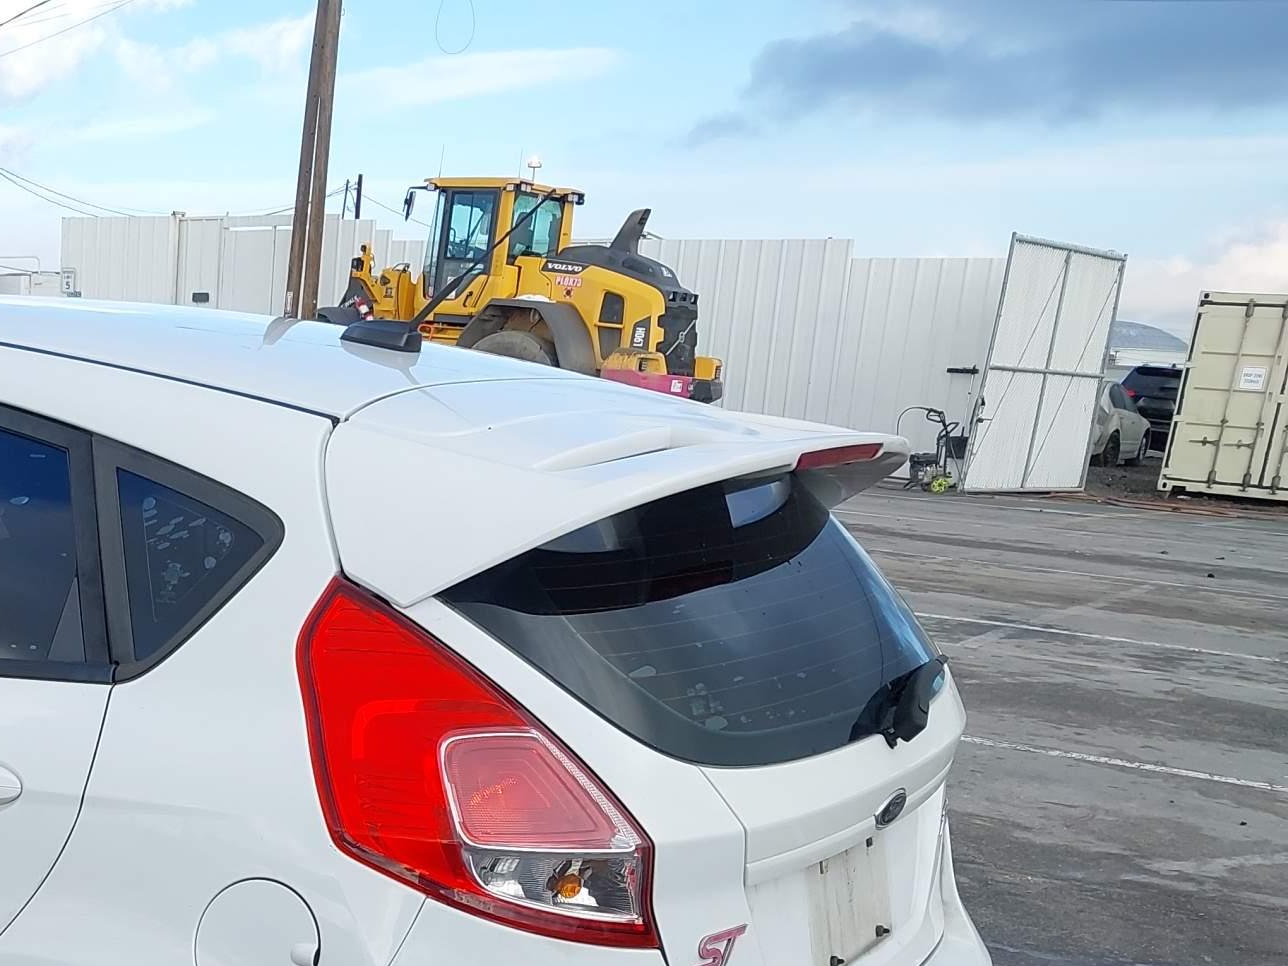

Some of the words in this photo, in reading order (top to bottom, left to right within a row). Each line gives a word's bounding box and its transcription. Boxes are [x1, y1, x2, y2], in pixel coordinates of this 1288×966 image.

[547, 262, 583, 273] VOLVO
[65, 281, 71, 290] 5
[632, 327, 646, 347] L90H
